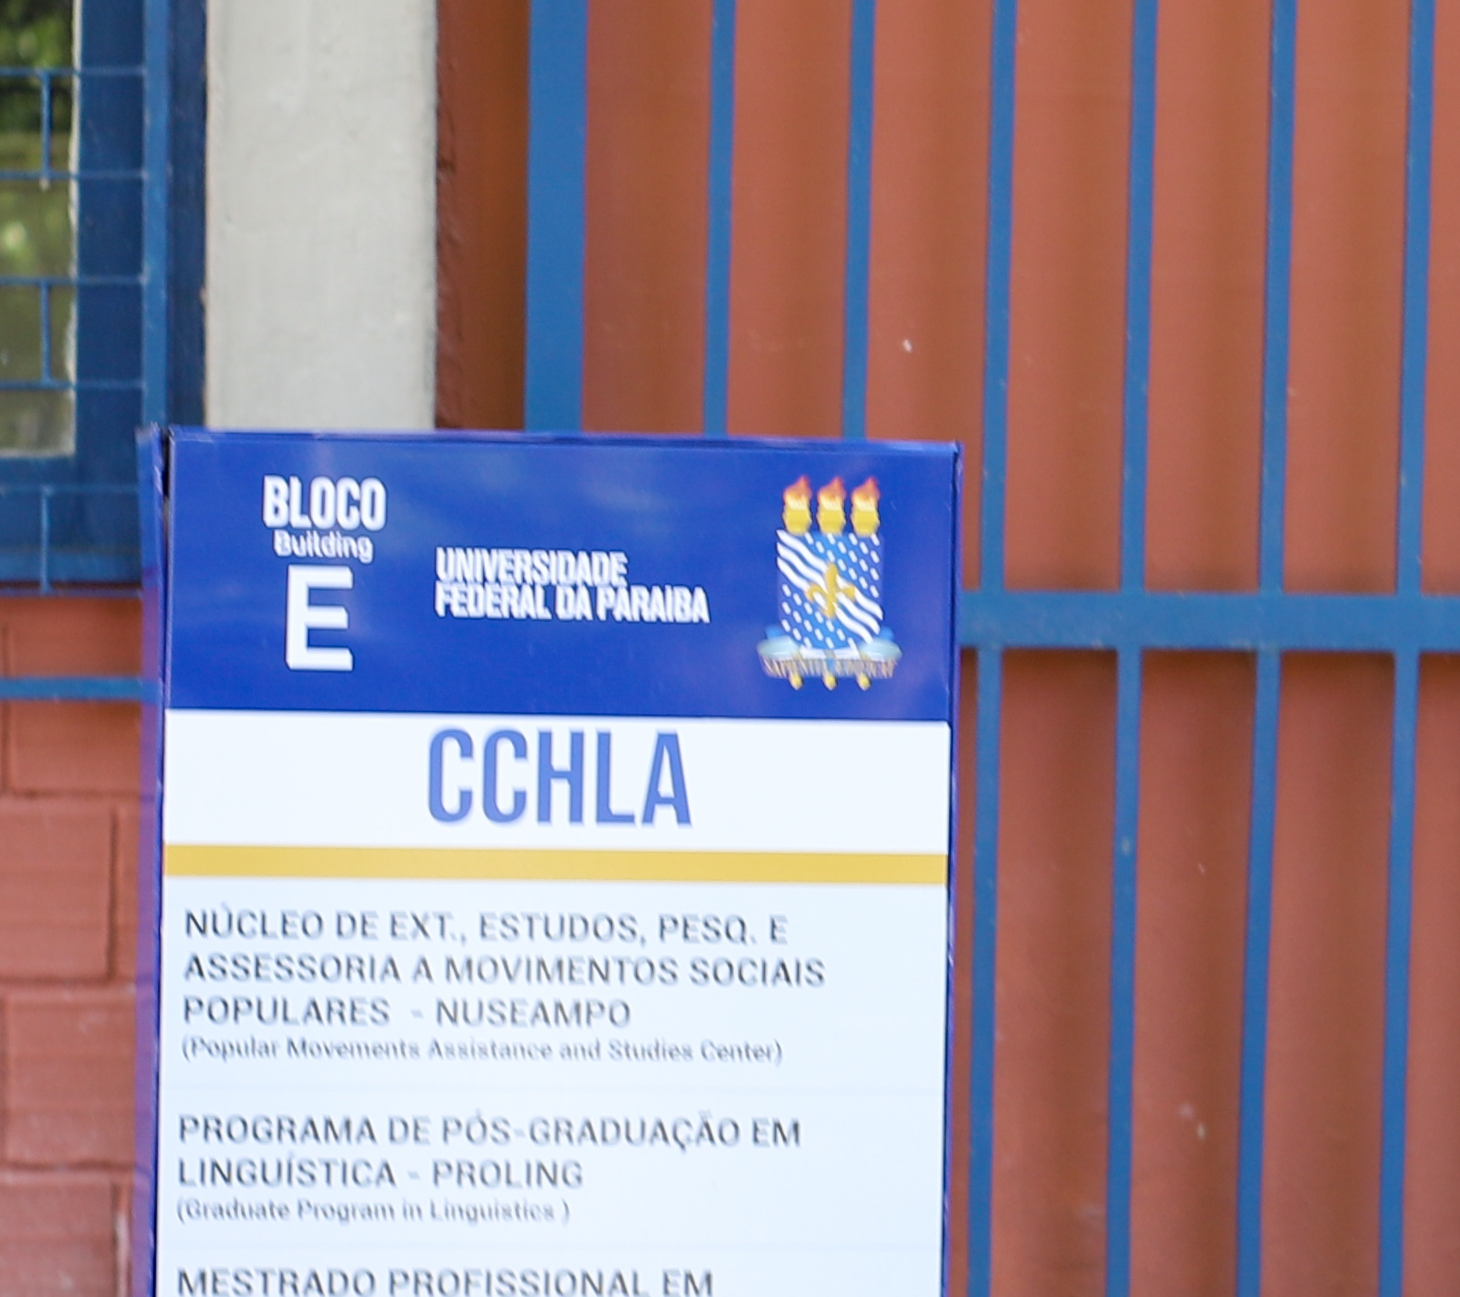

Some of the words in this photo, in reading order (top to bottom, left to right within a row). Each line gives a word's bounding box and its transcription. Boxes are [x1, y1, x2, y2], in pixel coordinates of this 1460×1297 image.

[263, 475, 387, 531] BLOCO
[274, 529, 374, 564] Building
[436, 548, 628, 586] UNIVERSIDADE
[285, 564, 354, 671] E
[435, 581, 552, 620] FEDERAL
[555, 584, 594, 621] DA
[428, 728, 692, 824] CCHLA
[185, 903, 324, 939] NÚCLEO
[336, 911, 378, 940] DE
[390, 912, 467, 946] EXT.,
[479, 913, 646, 945] ESTUDOS,
[659, 914, 756, 945] PESQ.
[770, 916, 787, 944] E
[184, 954, 401, 983] ASSESSORIA
[412, 955, 434, 983] A
[445, 956, 678, 985] MOVIMENTOS
[689, 958, 825, 987] SOCIAIS
[184, 996, 390, 1026] POPULARES
[436, 999, 630, 1028] NUSEAMPO
[182, 1034, 280, 1063] (Popular
[287, 1036, 421, 1060] Movements
[427, 1037, 553, 1060] Assistance
[559, 1038, 601, 1061] and
[608, 1038, 693, 1062] Studies
[700, 1038, 783, 1067] Center)
[179, 1115, 377, 1144] PROGRAMA
[388, 1117, 430, 1144] DE
[442, 1111, 740, 1152] PÓS-GRADUAÇÃO
[752, 1118, 800, 1147] EM
[179, 1152, 396, 1188] LINGUÍSTICA
[433, 1160, 583, 1188] PROLING
[177, 1196, 290, 1225] (Graduate
[297, 1198, 395, 1226] Program
[402, 1198, 423, 1221] in
[430, 1198, 555, 1226] Linguistics
[178, 1268, 376, 1297] MESTRADO
